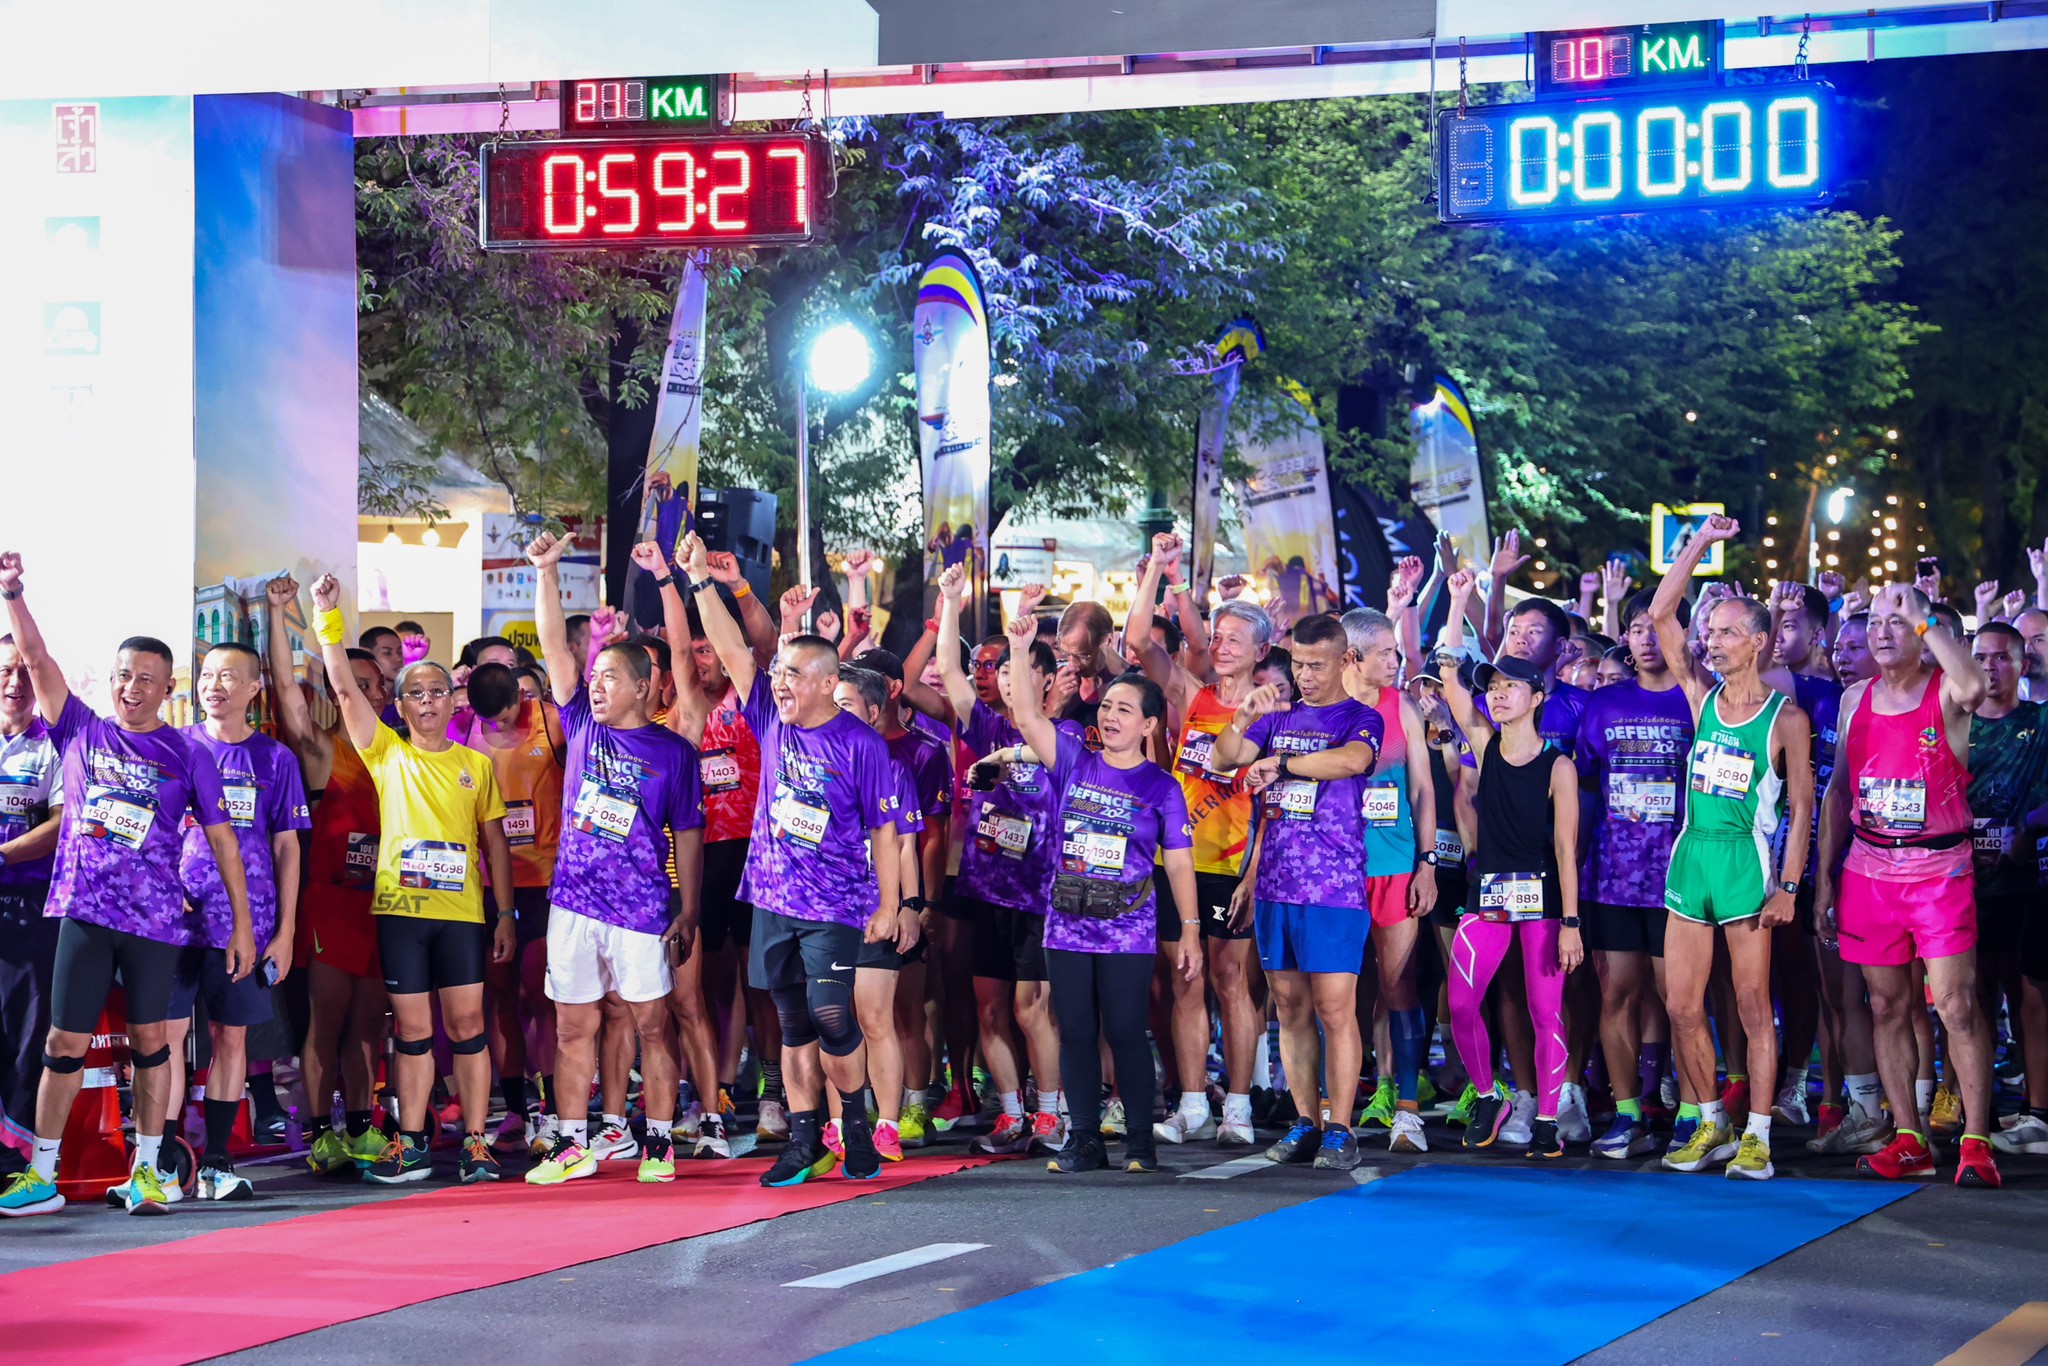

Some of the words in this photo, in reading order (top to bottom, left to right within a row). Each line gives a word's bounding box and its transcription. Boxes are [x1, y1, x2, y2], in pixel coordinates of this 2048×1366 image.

[1605, 725, 1681, 741] DEFENCE
[1617, 740, 1652, 752] RUN
[1716, 767, 1749, 783] 5080
[1067, 783, 1132, 809] DEFENCE
[1070, 799, 1102, 814] RUN
[1100, 805, 1133, 821] 2024
[506, 819, 529, 829] 1491
[1092, 818, 1115, 827] HEART
[371, 893, 429, 913] SAT
